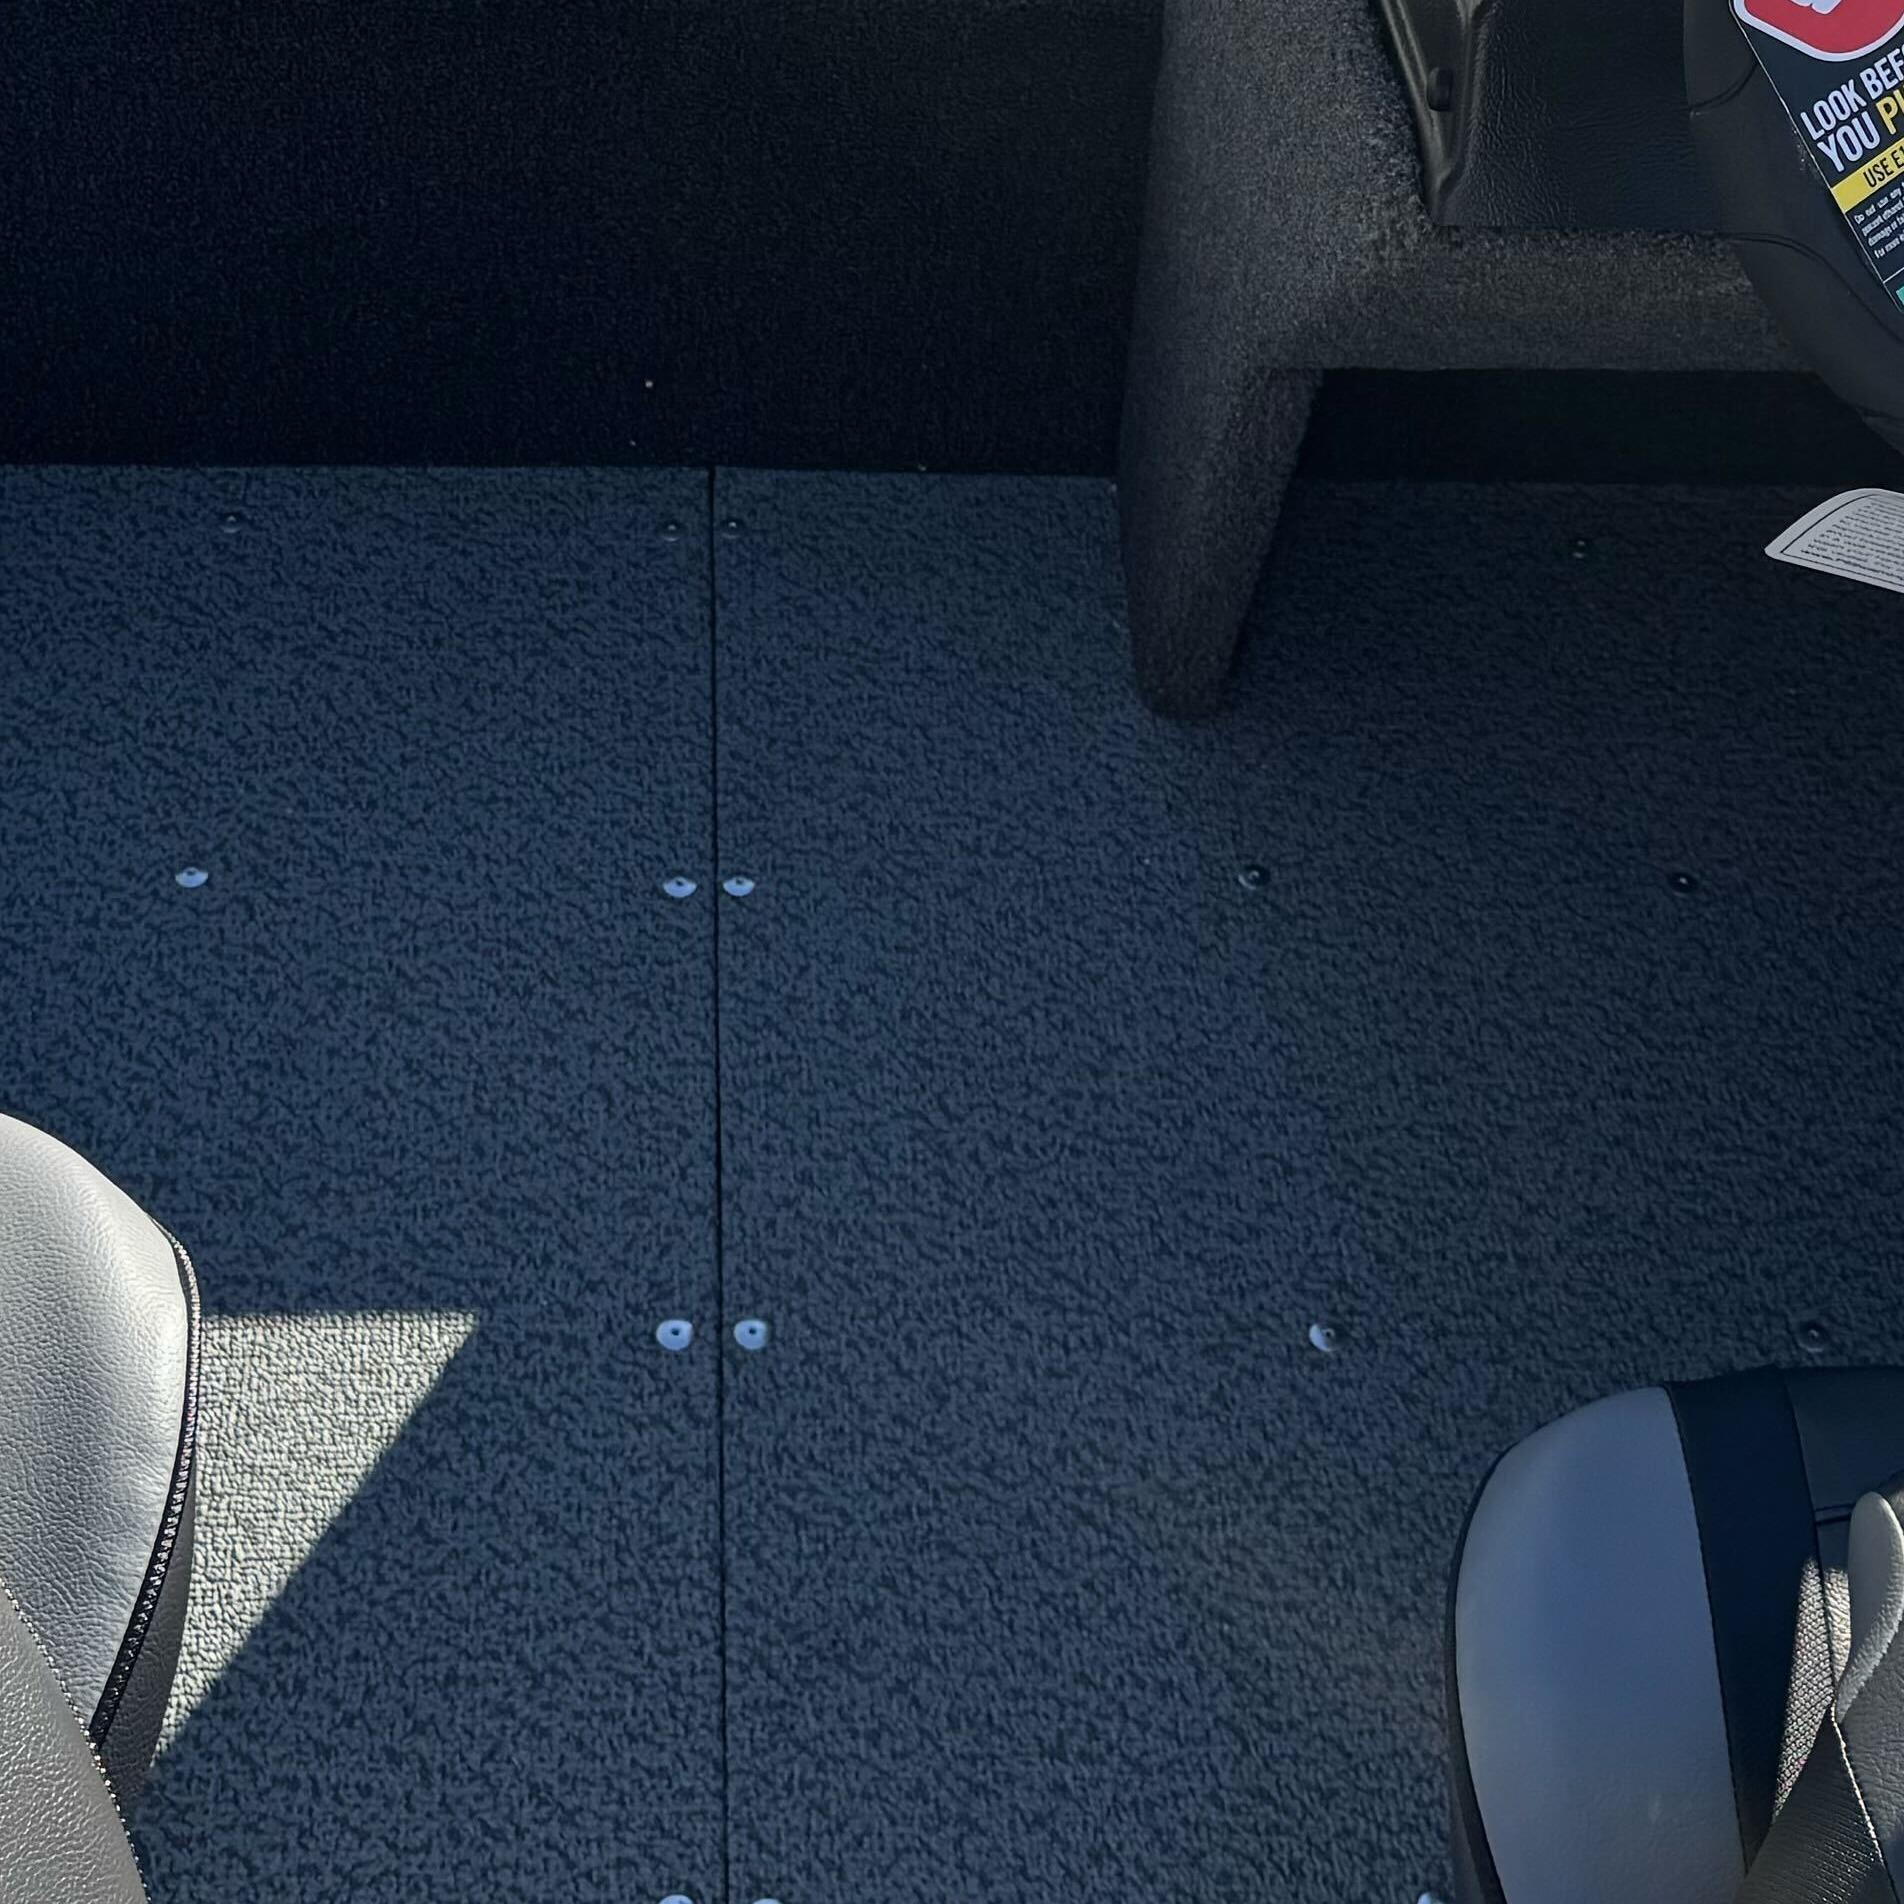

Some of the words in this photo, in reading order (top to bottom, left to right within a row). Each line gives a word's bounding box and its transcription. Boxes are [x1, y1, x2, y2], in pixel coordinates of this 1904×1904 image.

[1801, 78, 1867, 141] LOOK
[1817, 110, 1881, 173] YOU
[1863, 156, 1897, 189] USE
